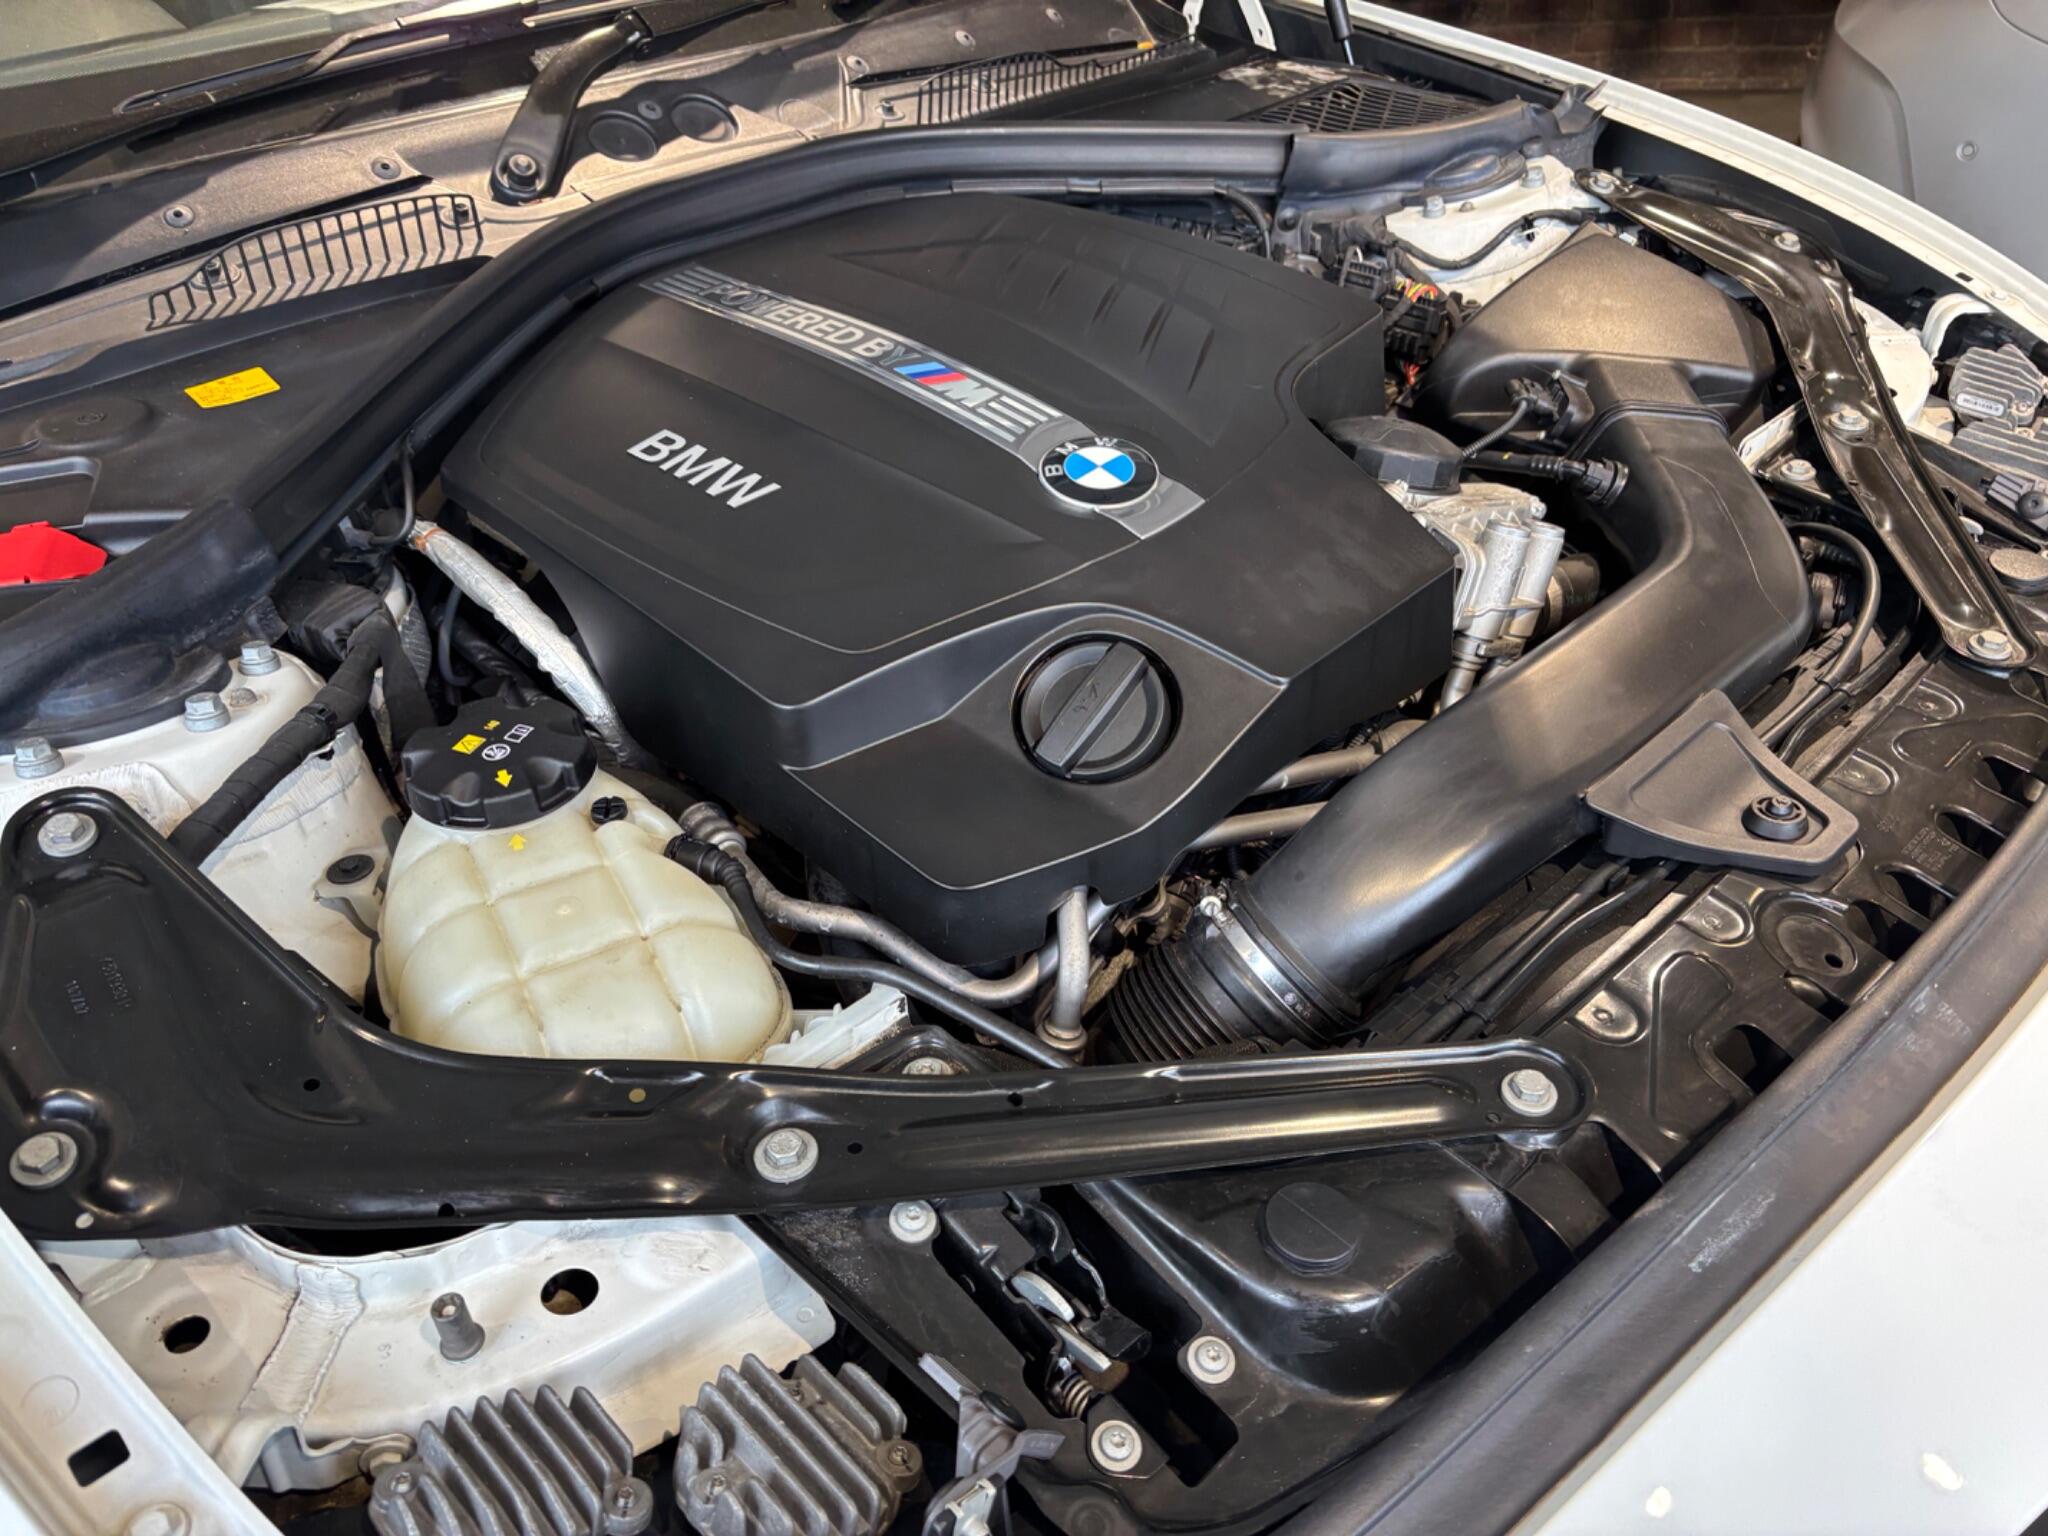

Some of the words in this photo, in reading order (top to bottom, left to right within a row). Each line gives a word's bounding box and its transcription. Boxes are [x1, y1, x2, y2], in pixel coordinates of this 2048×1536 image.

[698, 282, 864, 345] POWERED
[851, 337, 921, 367] BY
[626, 428, 782, 508] BMW
[1043, 436, 1119, 478] BMW
